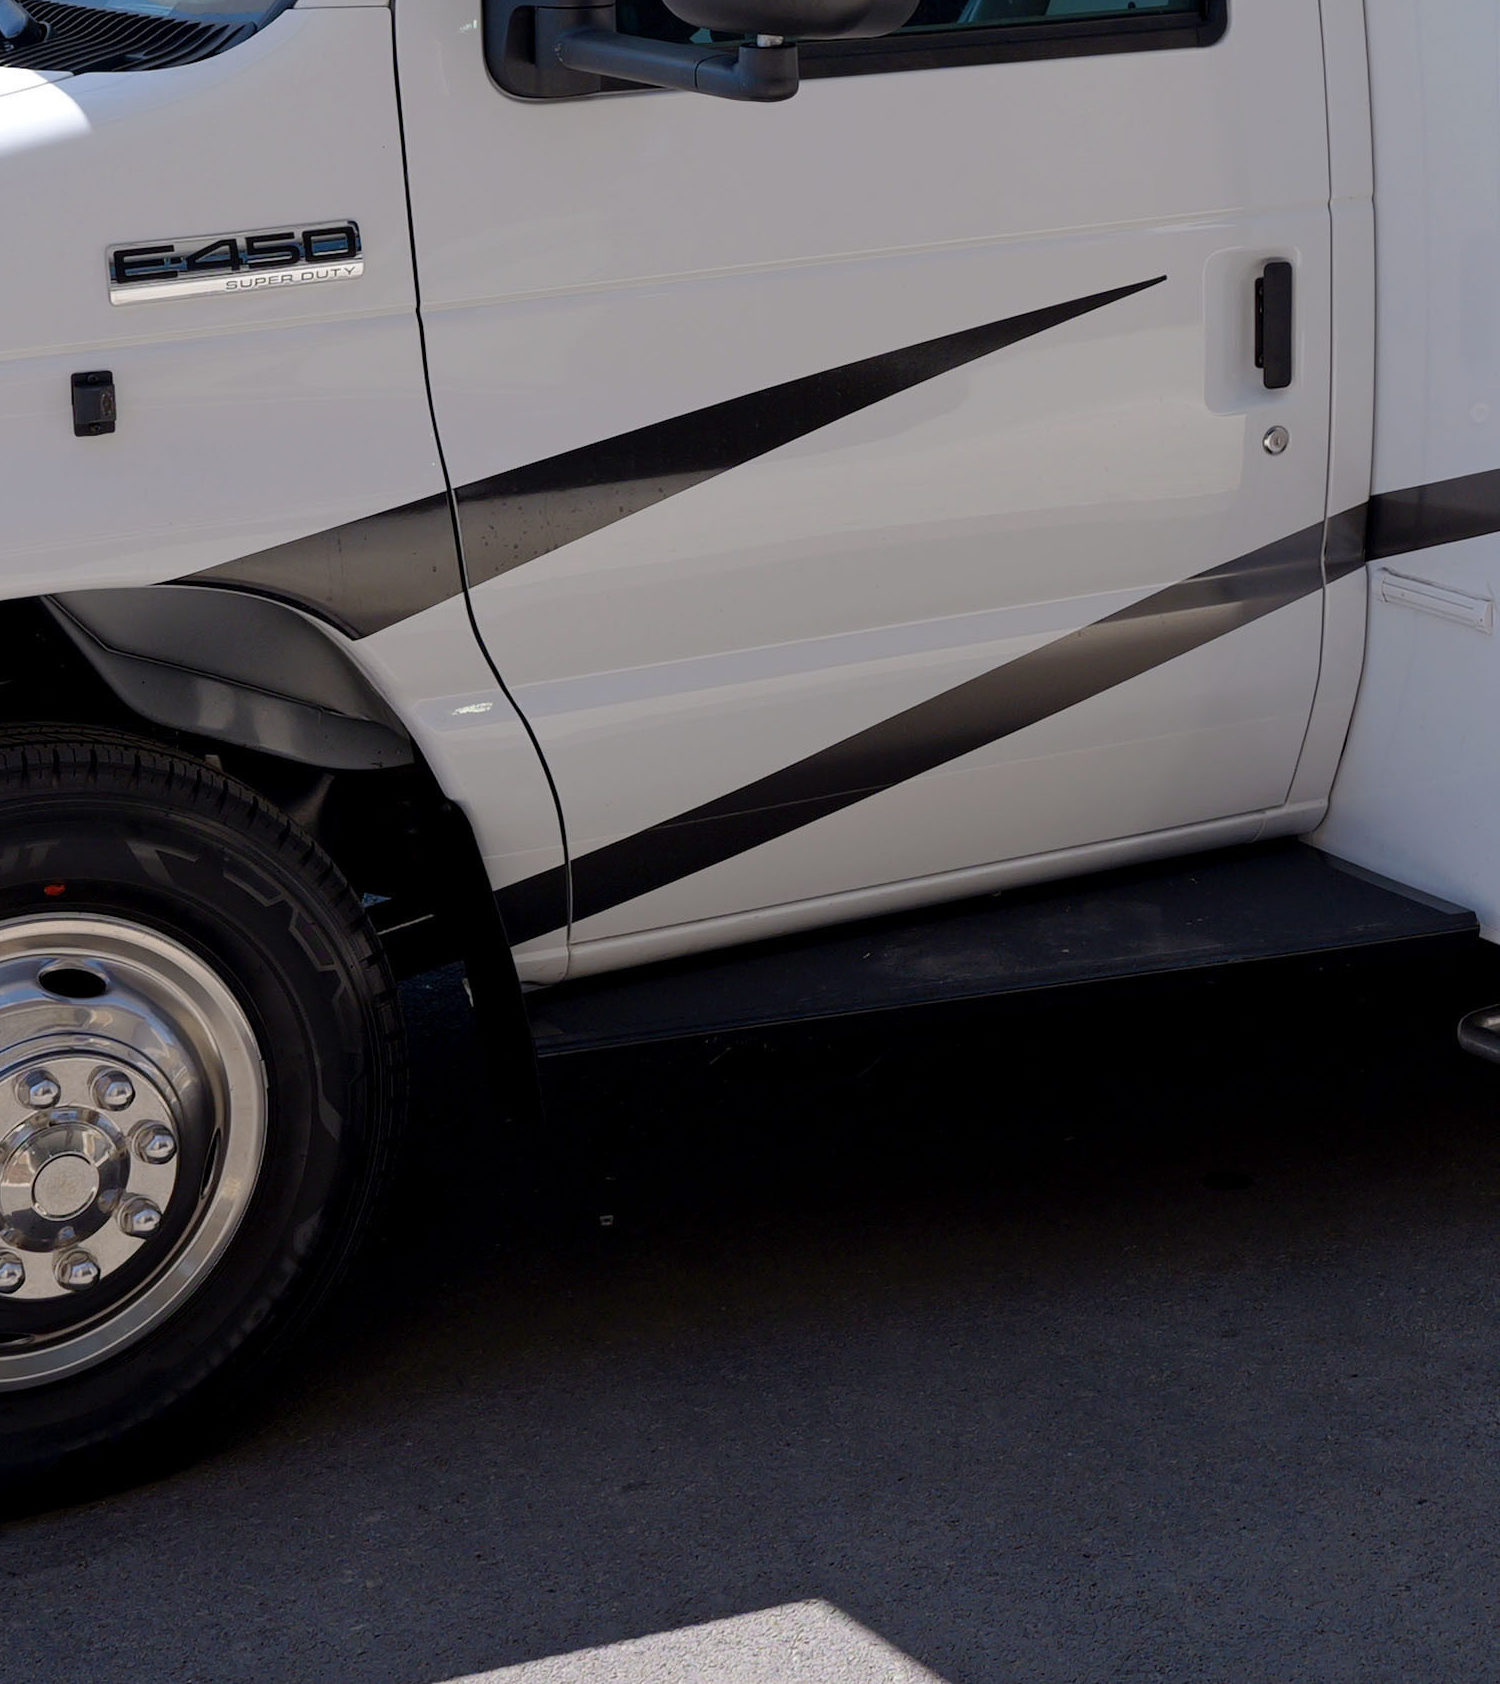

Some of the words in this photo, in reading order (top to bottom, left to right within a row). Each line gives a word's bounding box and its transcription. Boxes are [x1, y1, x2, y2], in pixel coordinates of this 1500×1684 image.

[113, 226, 357, 284] E-450
[225, 274, 293, 291] SUPER
[300, 266, 356, 282] DUTY
